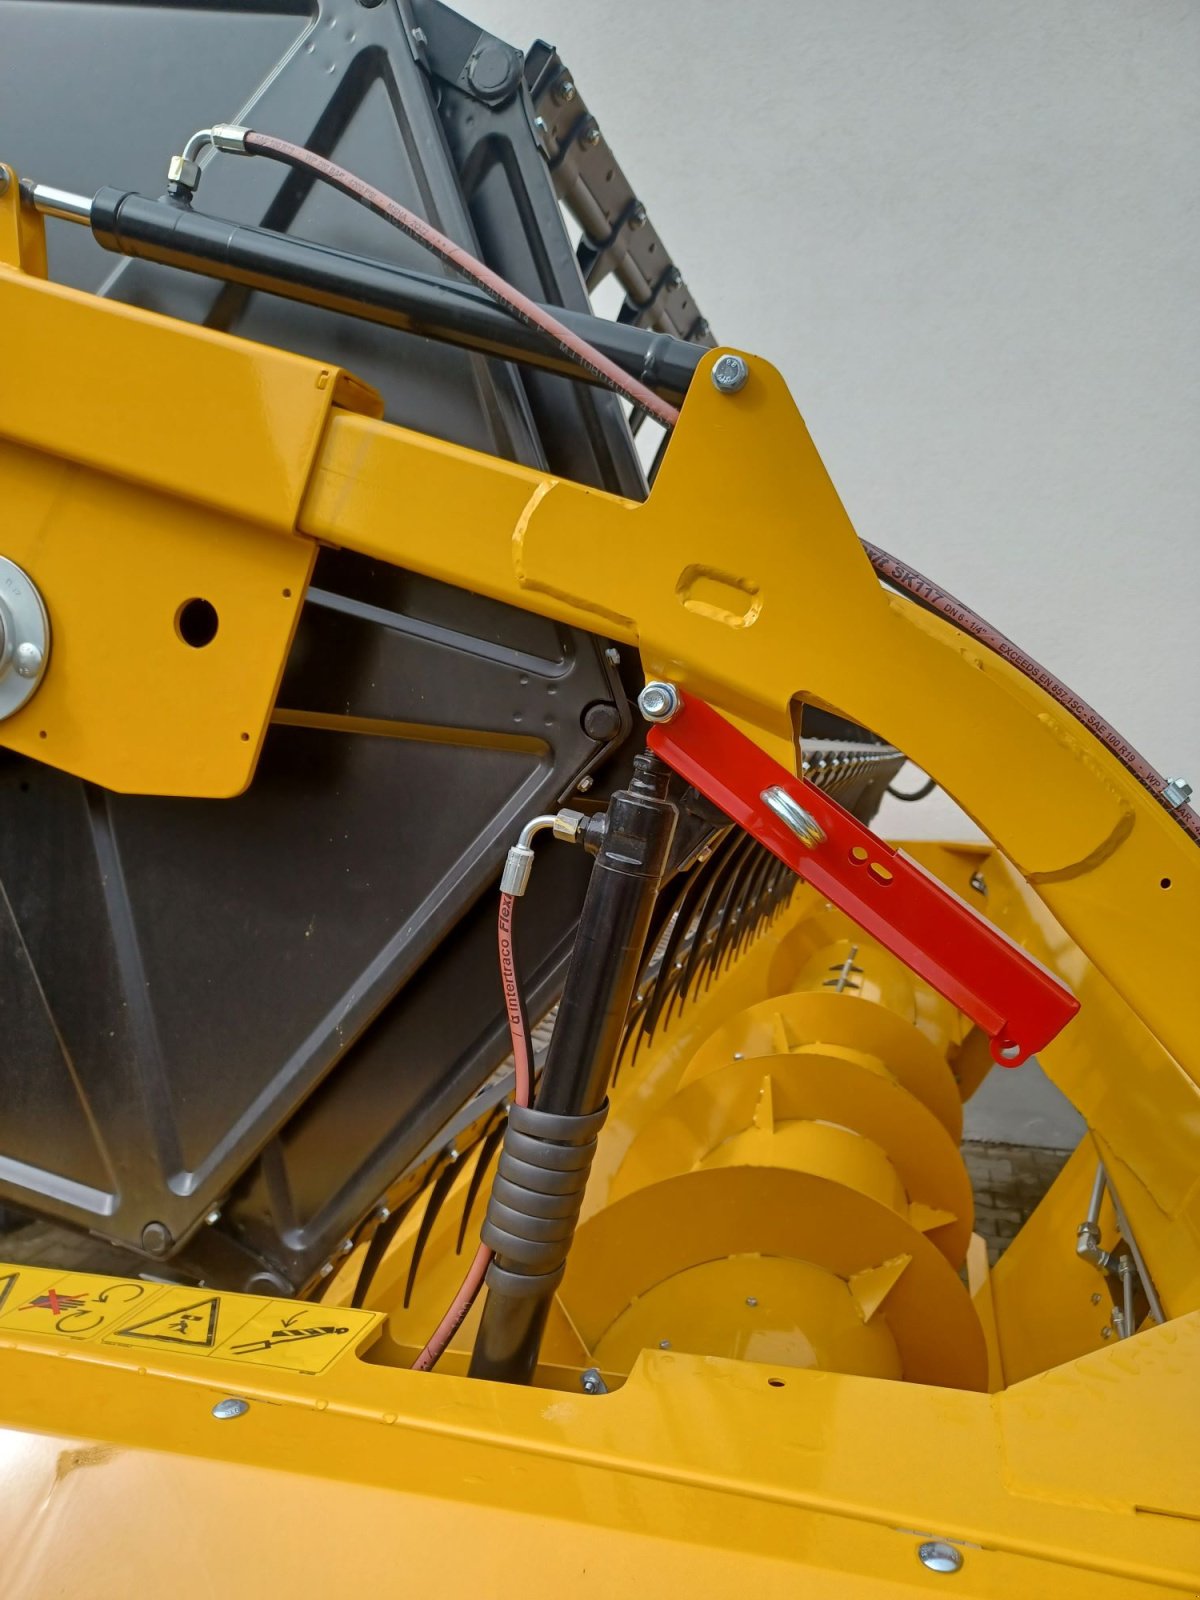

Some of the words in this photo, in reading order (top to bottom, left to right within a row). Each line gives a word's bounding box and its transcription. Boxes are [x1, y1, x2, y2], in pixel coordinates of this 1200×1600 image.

[892, 566, 944, 603] SK117
[943, 604, 959, 617] DN
[957, 611, 964, 621] 6
[999, 642, 1040, 677] EXCEEDS
[1038, 673, 1053, 688] EN
[1051, 684, 1068, 700] 857
[1087, 715, 1107, 735] SAE
[1105, 731, 1121, 748] 100
[1119, 745, 1136, 763] R19
[1145, 772, 1161, 788] WP
[501, 938, 520, 1015] intertraco
